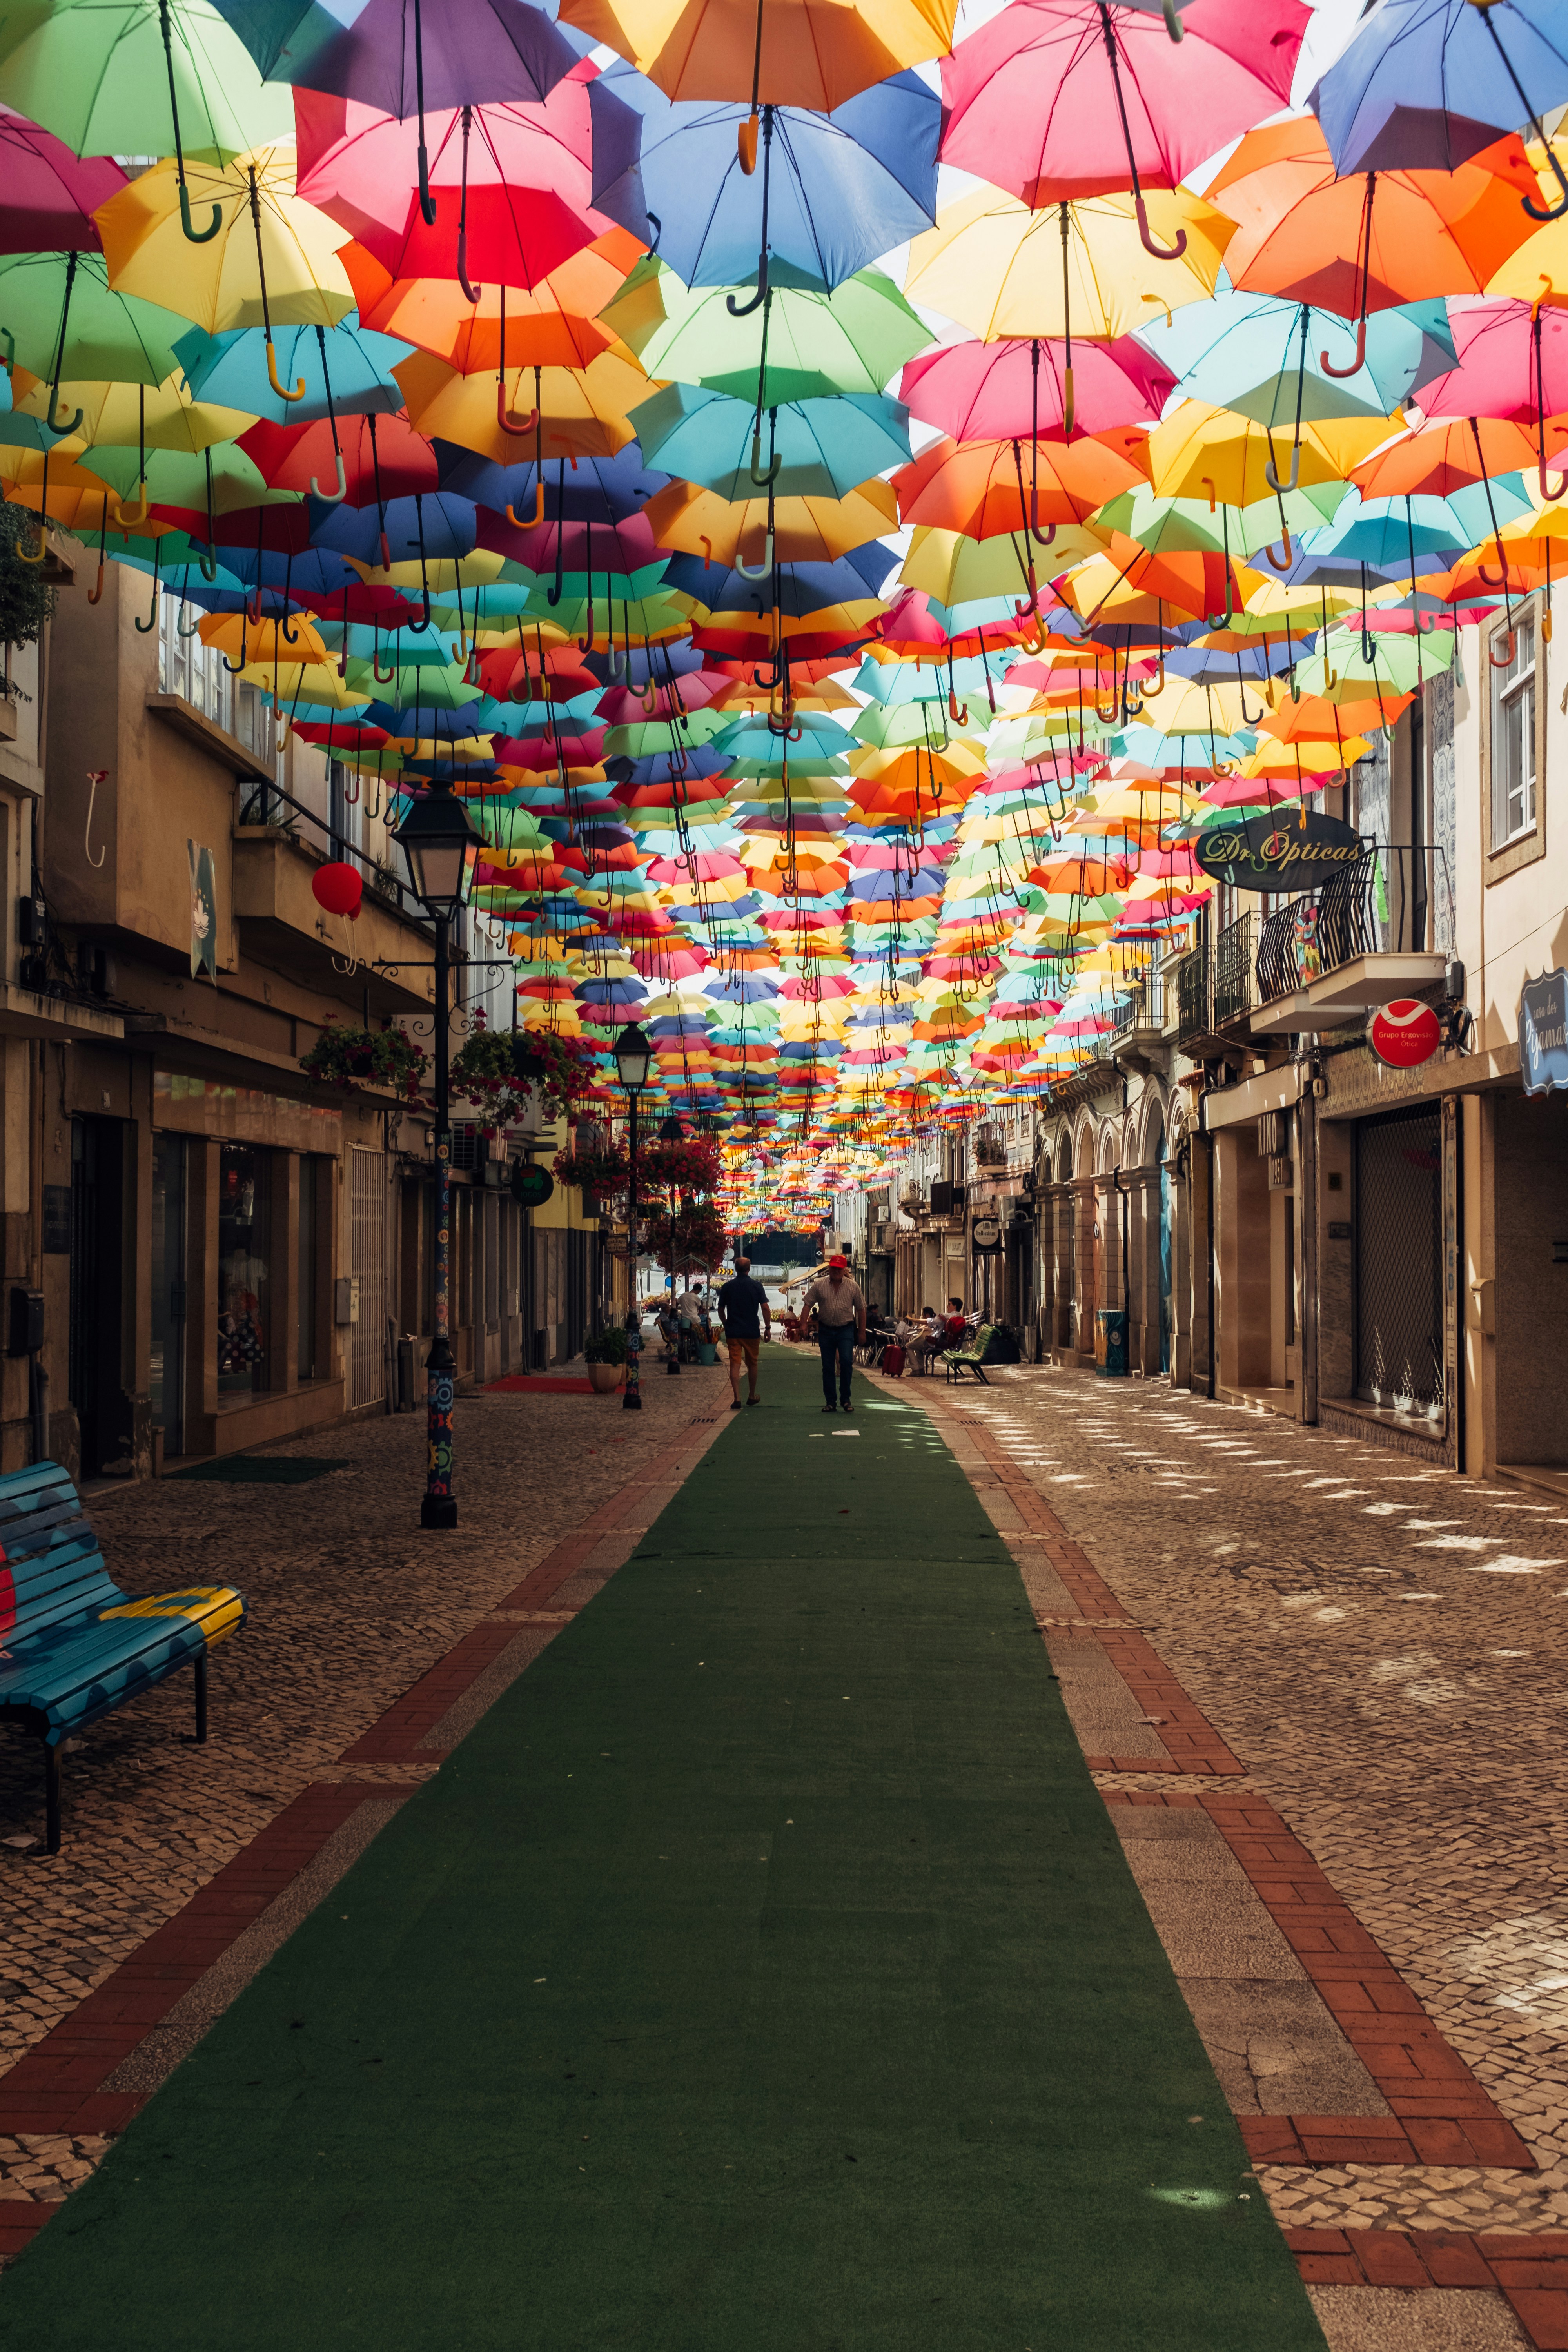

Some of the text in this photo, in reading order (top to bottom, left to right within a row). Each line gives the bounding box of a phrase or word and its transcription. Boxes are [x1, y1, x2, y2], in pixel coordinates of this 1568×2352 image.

[1203, 824, 1361, 872] Dr. Ópticas
[1533, 994, 1557, 1019] casa dos
[1526, 1018, 1568, 1071] Pijamas
[1258, 1112, 1277, 1158] RINO
[1272, 1158, 1282, 1183] 1951
